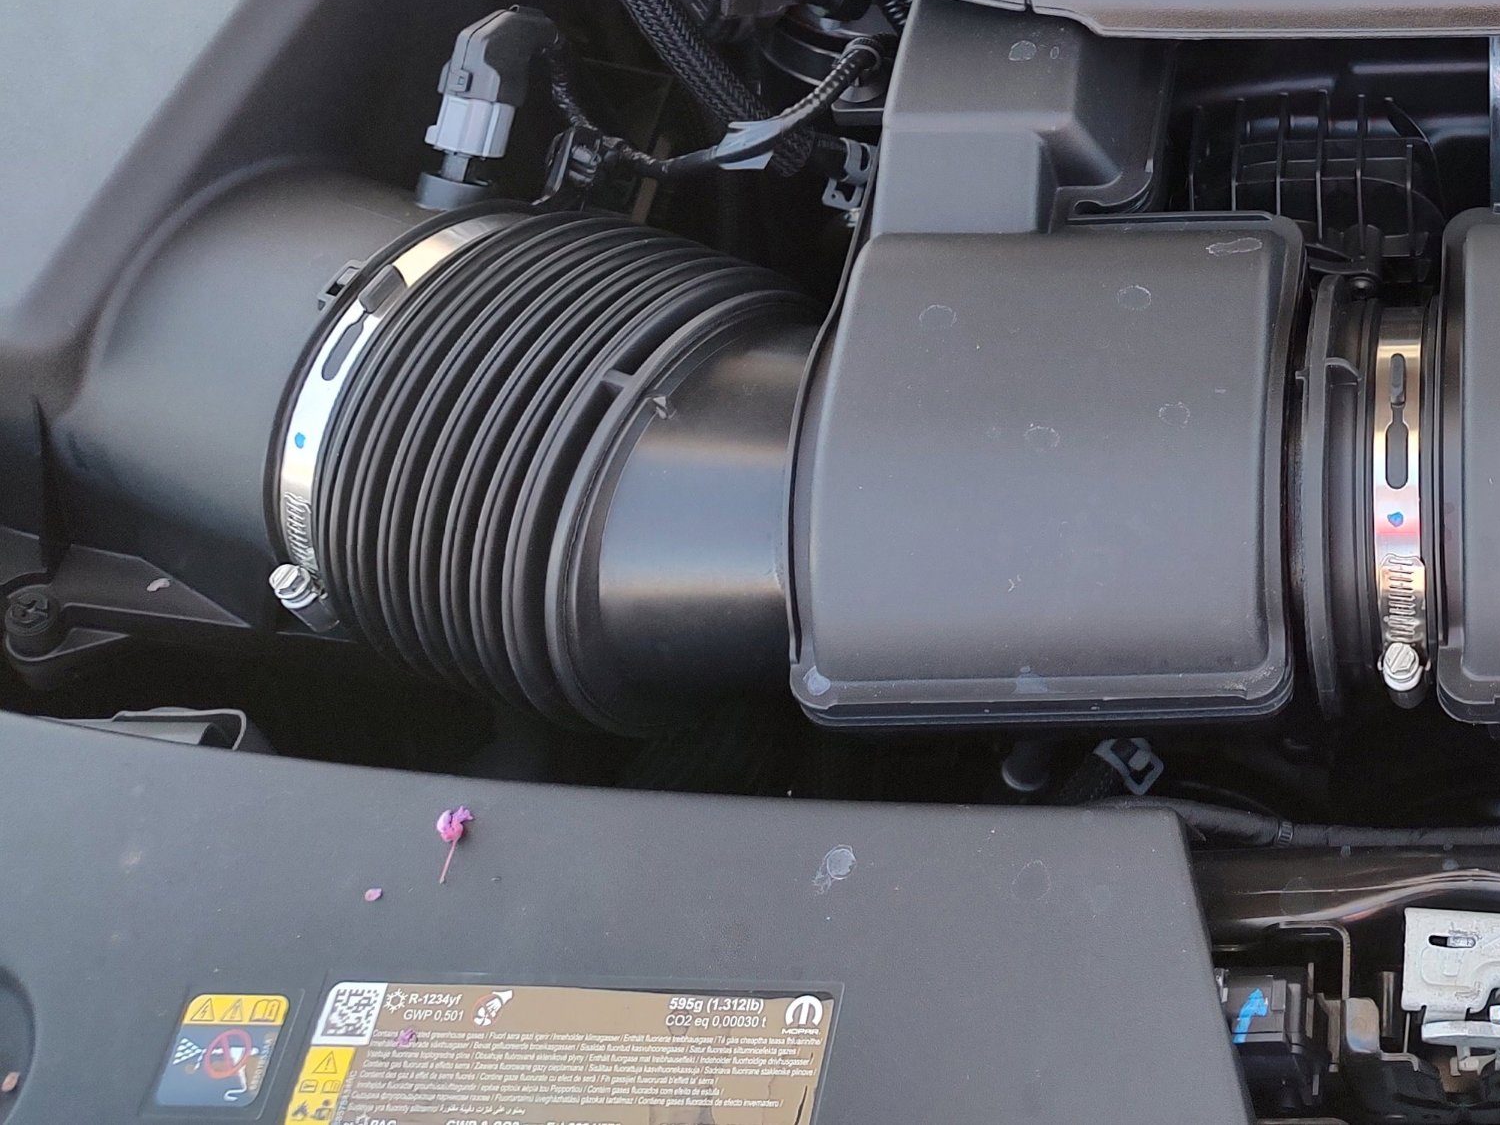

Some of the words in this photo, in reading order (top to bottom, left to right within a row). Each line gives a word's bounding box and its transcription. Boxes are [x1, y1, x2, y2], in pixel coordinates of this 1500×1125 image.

[408, 993, 463, 1008] R-1234yf
[669, 997, 704, 1012] 595g
[706, 998, 764, 1013] (1.312lb)
[403, 1008, 433, 1021] GWP
[433, 1009, 465, 1022] 0,501
[665, 1014, 692, 1026] CO2
[694, 1017, 709, 1029] eq
[711, 1016, 760, 1028] 0,00030
[781, 1027, 820, 1036] MOPAR
